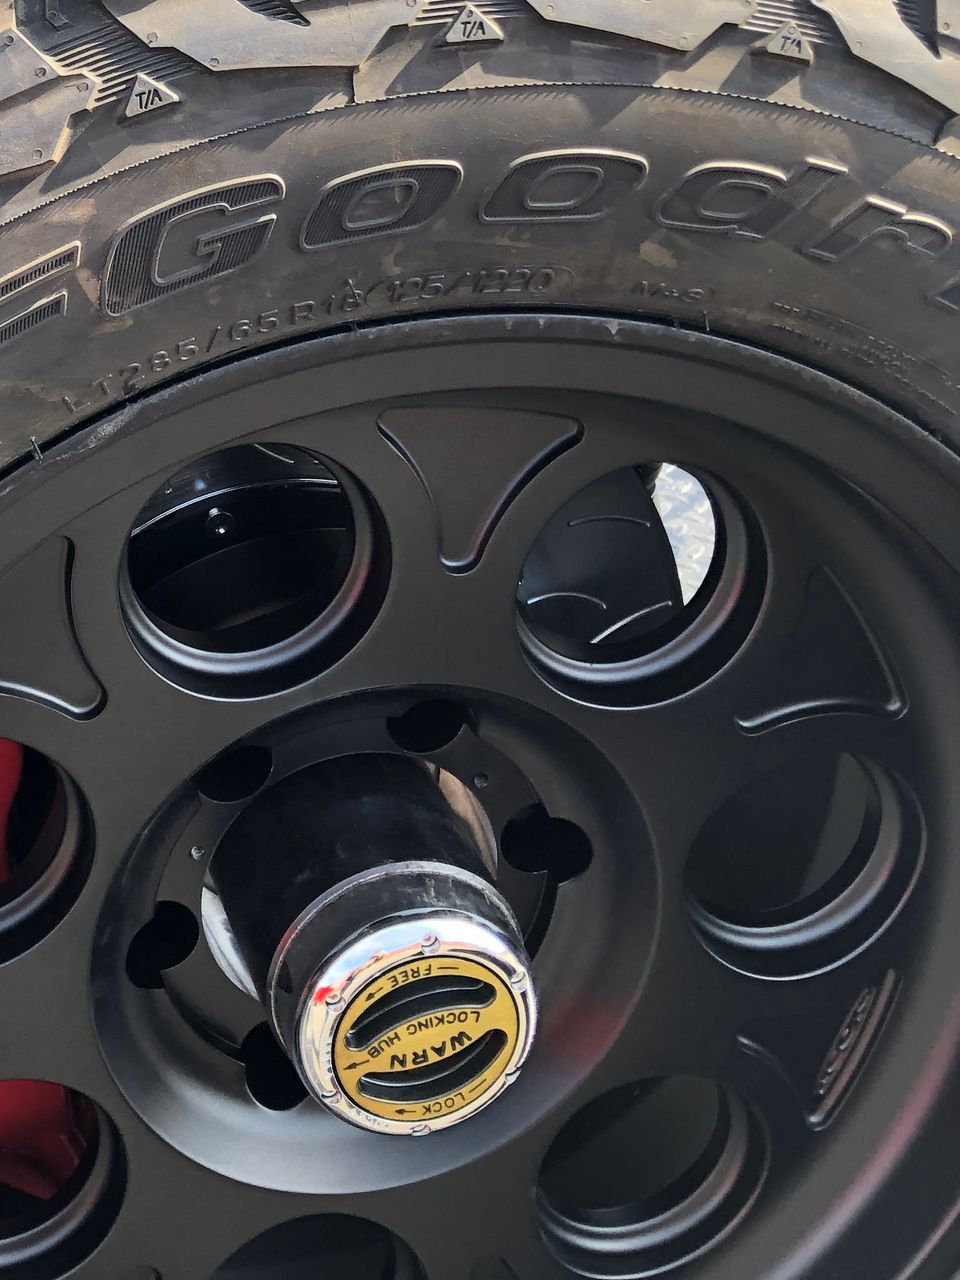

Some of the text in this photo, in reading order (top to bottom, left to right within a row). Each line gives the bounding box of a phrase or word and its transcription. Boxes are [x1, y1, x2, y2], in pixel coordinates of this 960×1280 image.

[460, 21, 486, 39] T/A
[134, 88, 163, 110] T/A
[387, 963, 433, 987] FREE
[367, 1010, 481, 1059] LOCKING HUB
[390, 1031, 473, 1070] WARN
[422, 1092, 466, 1116] LOCK
